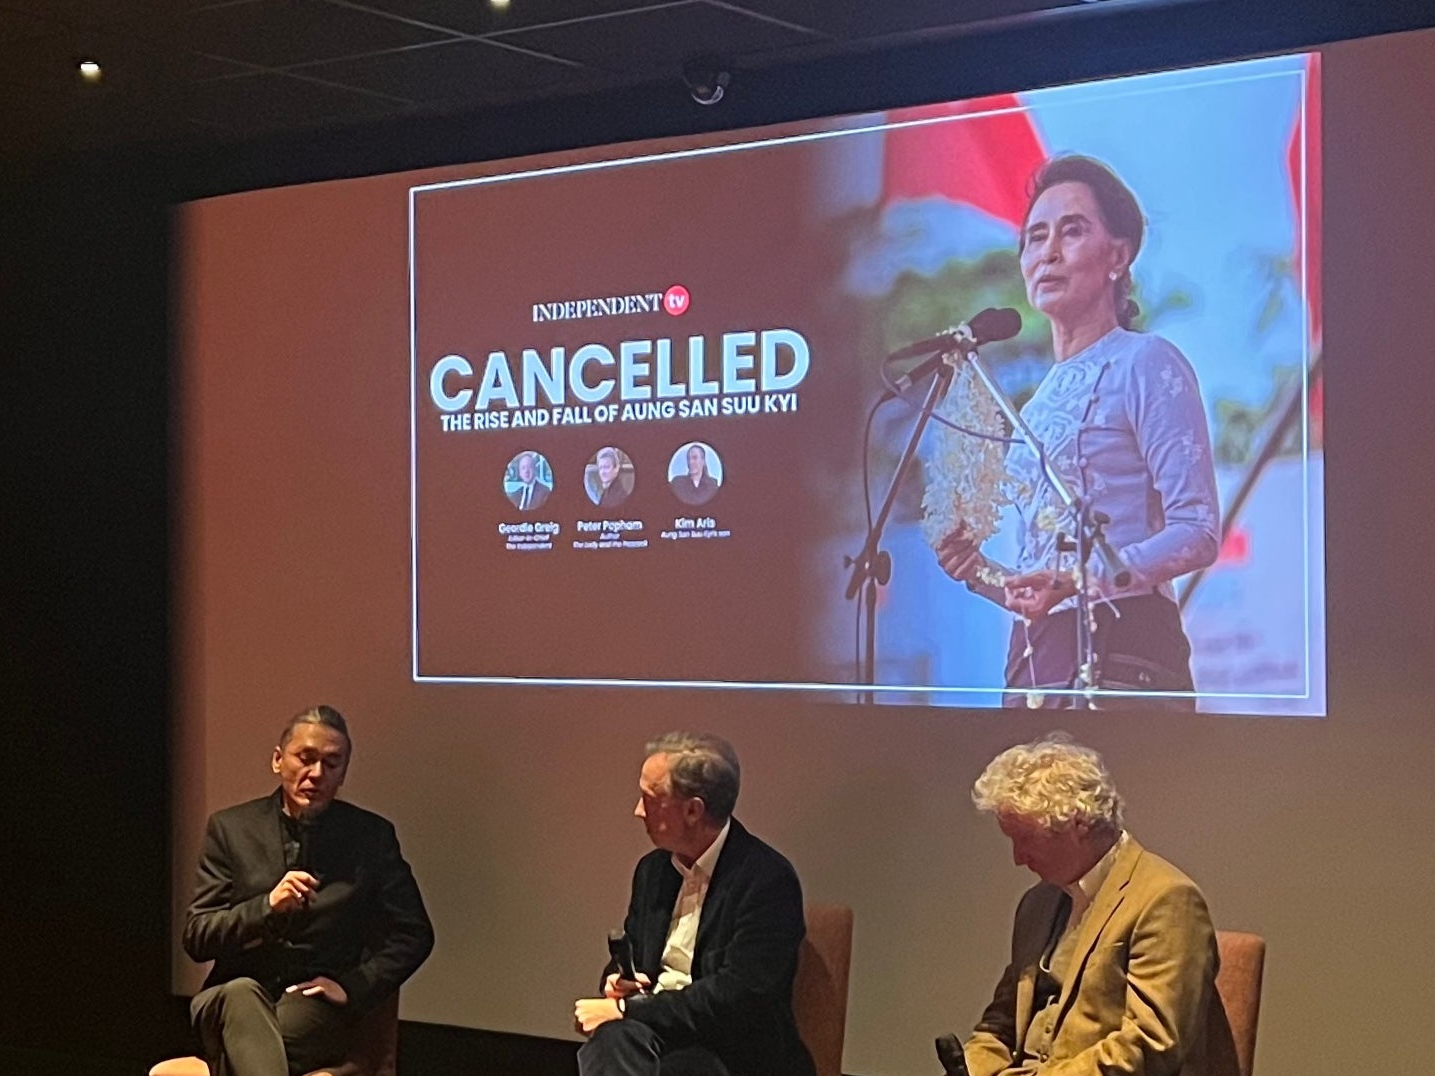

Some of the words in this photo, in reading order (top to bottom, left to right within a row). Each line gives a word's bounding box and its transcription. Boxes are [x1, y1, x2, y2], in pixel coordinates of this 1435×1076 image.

[532, 293, 663, 322] INDEPENDENT
[668, 294, 685, 309] tv
[430, 329, 810, 411] CANCELLED
[441, 413, 471, 432] THE
[473, 411, 509, 430] RISE
[511, 409, 549, 428] AND
[552, 406, 592, 425] FALL
[594, 404, 619, 423] OF
[621, 400, 675, 421] AUNG
[678, 397, 718, 418] SAN
[721, 394, 760, 415] SUU
[764, 392, 797, 412] KYI
[576, 520, 602, 532] Peter
[602, 519, 643, 533] Popham
[674, 517, 695, 529] Kim
[696, 516, 716, 529] Aris
